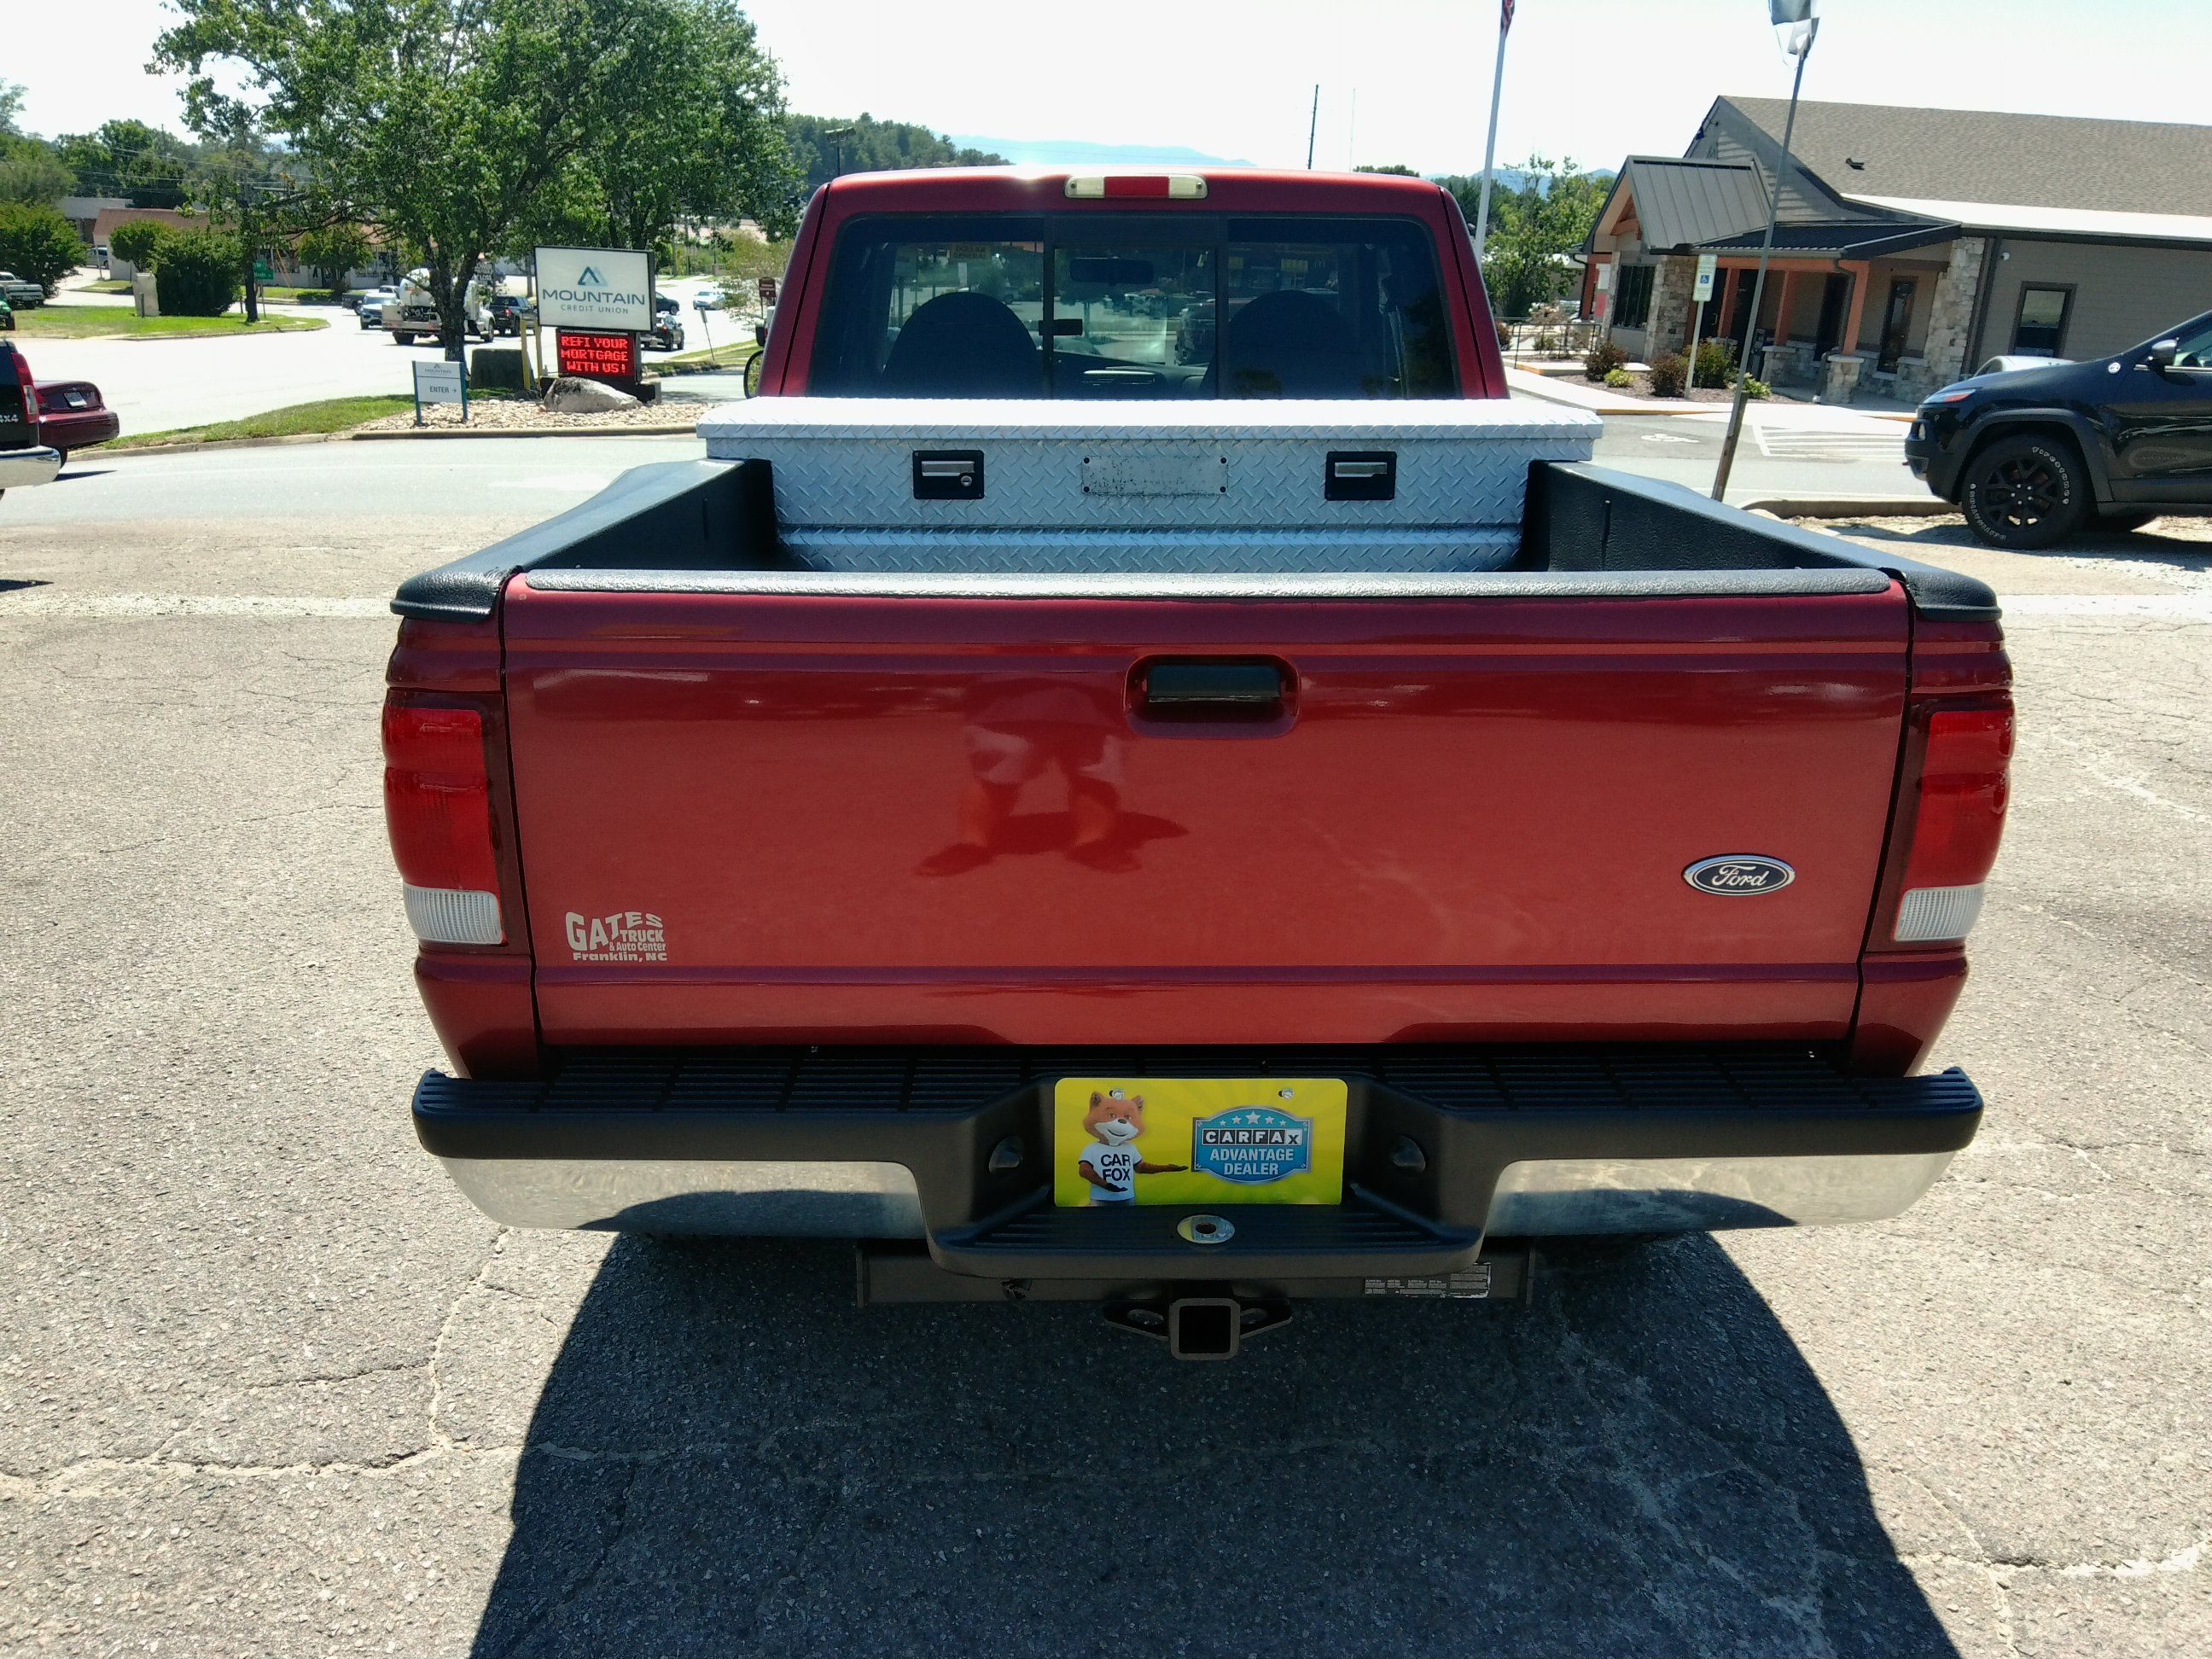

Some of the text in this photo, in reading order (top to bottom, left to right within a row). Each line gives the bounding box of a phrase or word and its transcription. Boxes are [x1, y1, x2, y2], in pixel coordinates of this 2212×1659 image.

[543, 289, 645, 305] MOUNTAIN
[561, 336, 628, 349] REFI YOUR
[561, 348, 628, 361] MORTGAGE
[567, 361, 626, 374] WITH US!
[1712, 864, 1770, 887] Ford
[566, 911, 663, 952] GATES
[620, 929, 665, 942] TRUCK
[609, 941, 666, 952] & Auto Center
[573, 952, 667, 963] Franklin, NC
[1203, 1129, 1301, 1145] CARFAX
[1101, 1154, 1131, 1167] CAR
[1209, 1149, 1294, 1161] ADVANTAGE
[1103, 1168, 1131, 1181] FOX
[1224, 1163, 1278, 1175] DEALER
